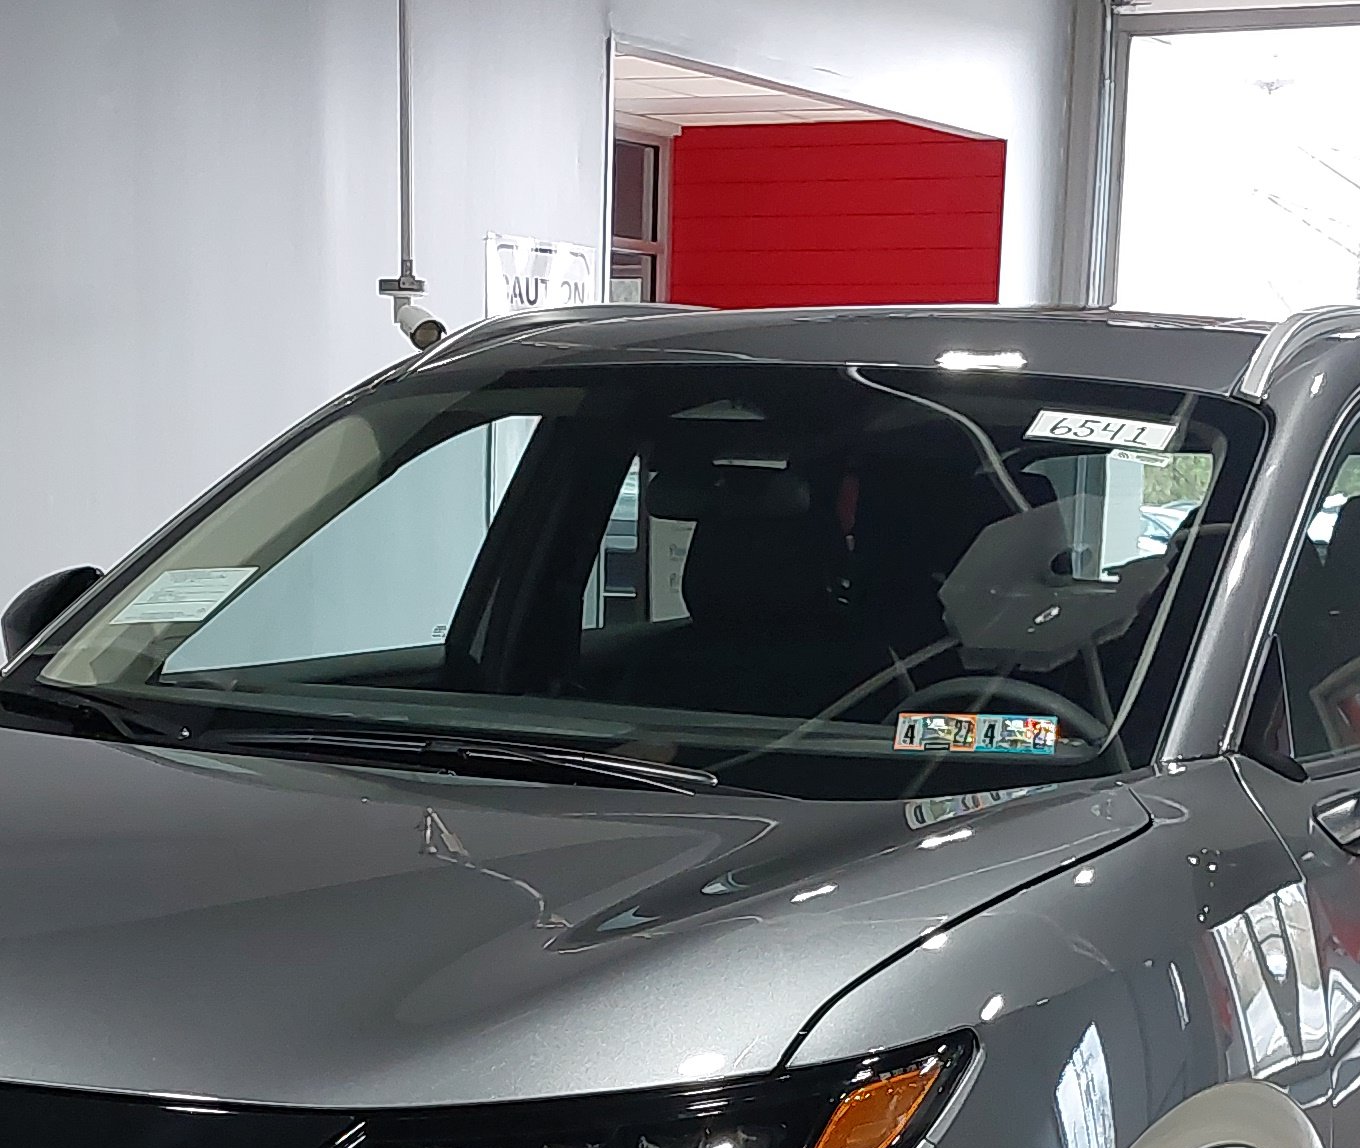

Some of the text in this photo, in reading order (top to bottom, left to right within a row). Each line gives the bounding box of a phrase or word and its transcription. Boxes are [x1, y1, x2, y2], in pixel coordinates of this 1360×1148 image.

[1049, 417, 1148, 446] 6541
[904, 723, 916, 745] 4
[983, 723, 996, 748] 4
